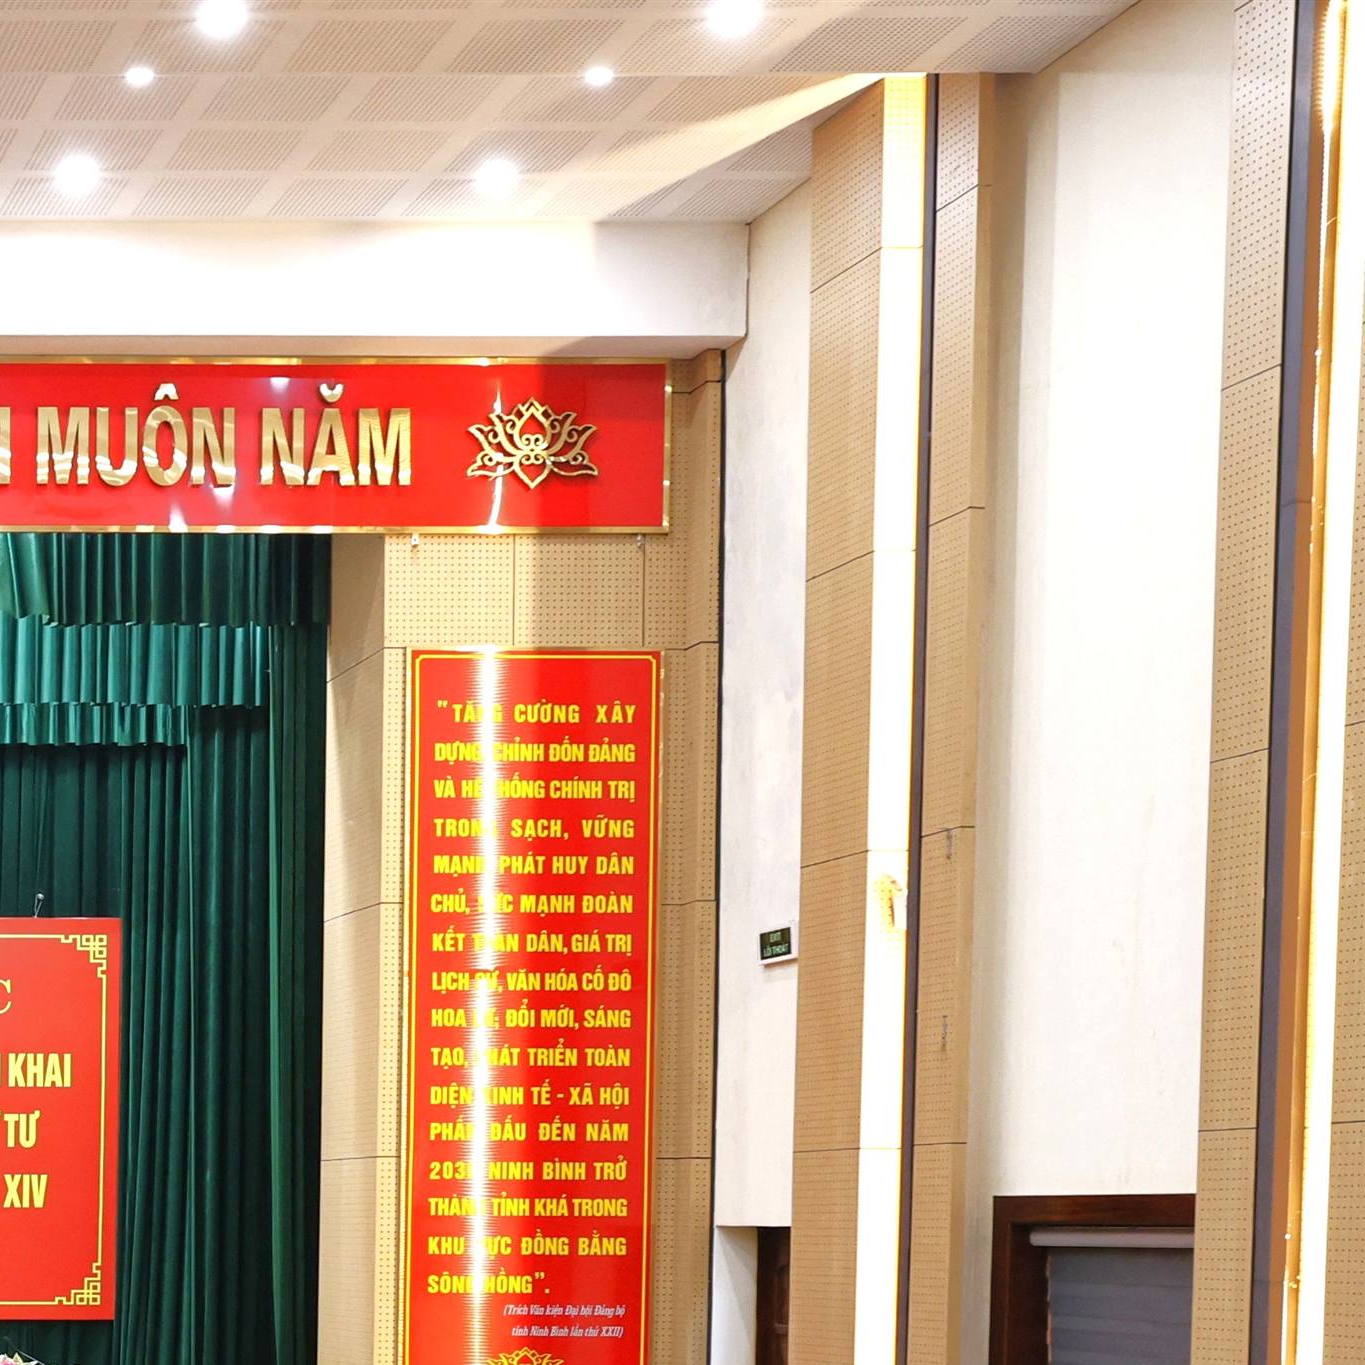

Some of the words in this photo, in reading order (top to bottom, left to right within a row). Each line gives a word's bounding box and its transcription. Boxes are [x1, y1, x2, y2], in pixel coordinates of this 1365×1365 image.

[35, 383, 237, 487] MUÔN
[261, 380, 414, 487] NĂM
[514, 699, 579, 723] CƯỜNG
[596, 701, 635, 723] XÂY
[589, 738, 635, 762] ĐẢNG
[434, 776, 455, 798] VÀ
[550, 777, 602, 798] CHÍNH
[608, 781, 635, 802] TRỊ
[510, 818, 568, 841] SẠCH,
[582, 815, 634, 838] VỮNG
[552, 856, 588, 874] HUY
[596, 852, 633, 874] DÂN
[431, 888, 470, 914] CHỦ,
[520, 895, 574, 916] MẠNH
[582, 892, 632, 913] ĐOÀN
[433, 926, 466, 951] KẾT
[526, 930, 567, 954] DÂN,
[572, 930, 600, 952] GIÁ
[606, 934, 631, 956] TRỊ
[432, 972, 471, 993] LỊCH
[506, 969, 540, 991] VĂN
[545, 969, 578, 991] HÓA
[608, 969, 631, 991] ĐÔ
[432, 1009, 469, 1028] HOA
[505, 999, 535, 1027] ĐỔI
[541, 1005, 579, 1029] MỚI,
[584, 1005, 631, 1027] SÁNG
[527, 1039, 577, 1066] TRIỂN
[585, 1045, 630, 1066] TOÀN
[9, 1053, 71, 1087] KHAI
[531, 1079, 550, 1104] TẾ
[569, 1083, 593, 1105] XÃ
[600, 1083, 629, 1109] HỘI
[4, 1110, 40, 1147] TƯ
[539, 1116, 575, 1141] ĐẾN
[586, 1120, 628, 1141] NĂM
[543, 1158, 586, 1180] BÌNH
[594, 1155, 627, 1180] TRỞ
[4, 1174, 47, 1208] XIV
[535, 1195, 568, 1216] KHÁ
[572, 1199, 627, 1216] TRONG
[520, 1229, 569, 1255] ĐỒNG
[578, 1231, 626, 1255] BẰNG
[530, 1326, 548, 1336] Ninh
[550, 1326, 569, 1336] Bình
